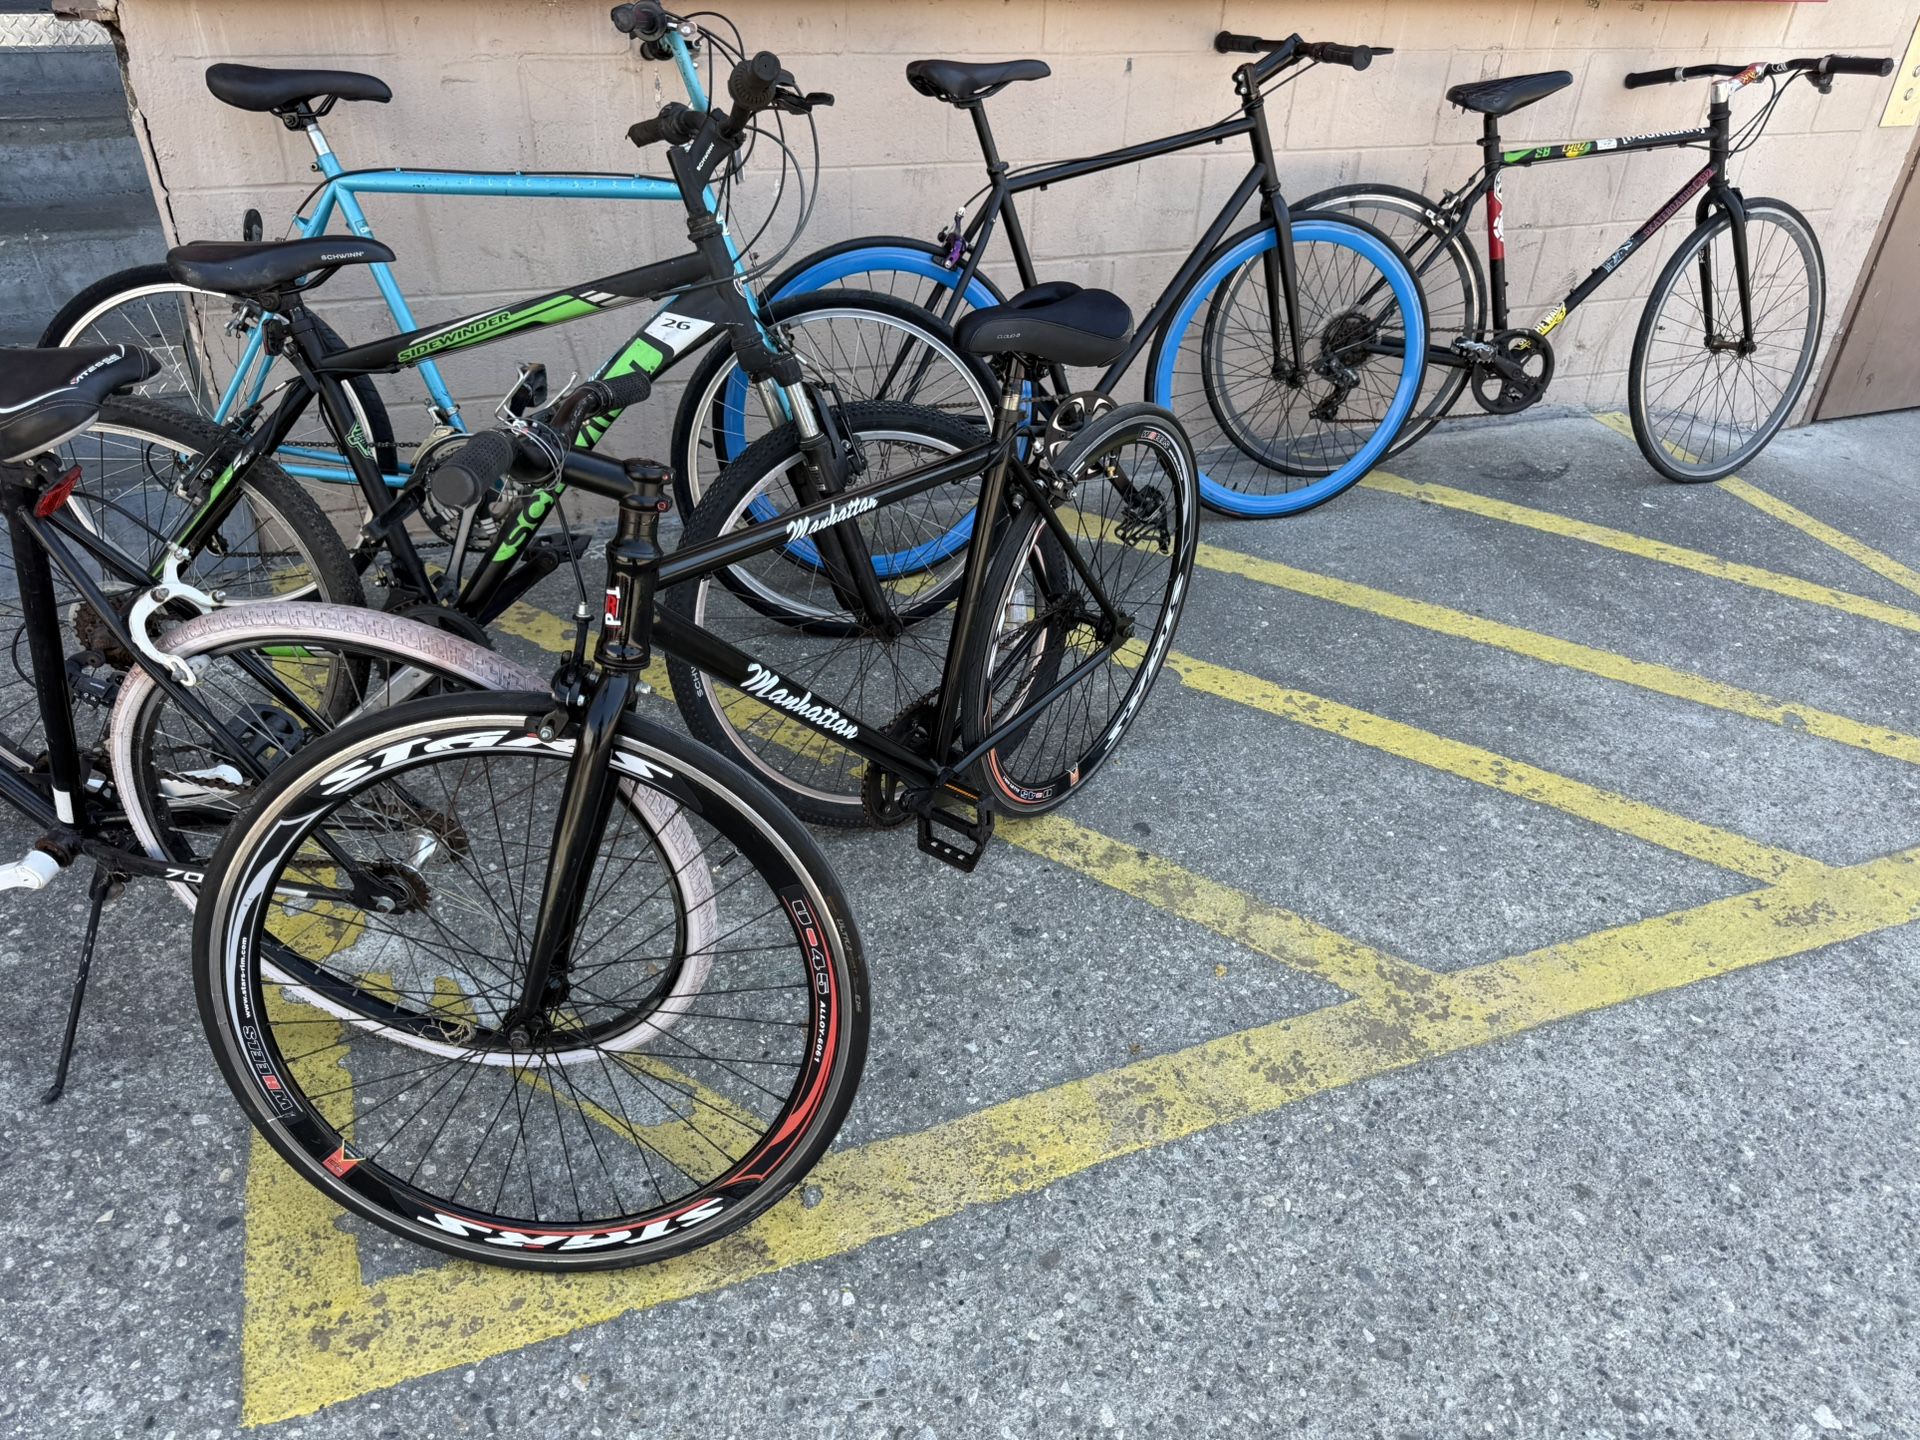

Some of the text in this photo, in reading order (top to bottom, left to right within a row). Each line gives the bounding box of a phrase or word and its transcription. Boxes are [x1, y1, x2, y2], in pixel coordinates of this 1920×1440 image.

[696, 142, 714, 171] SCHWINN
[321, 252, 364, 260] SCHWINN
[399, 311, 511, 361] SIDEWINDER
[661, 318, 691, 331] 26
[786, 496, 879, 543] Manhattan
[740, 662, 859, 740] Manhattan
[792, 899, 830, 995] U-45
[240, 936, 252, 1019] www.stars-rim.com
[813, 1000, 827, 1063] ALLOY-6061
[243, 1025, 293, 1111] WHEELS
[417, 1197, 724, 1250] STARS
